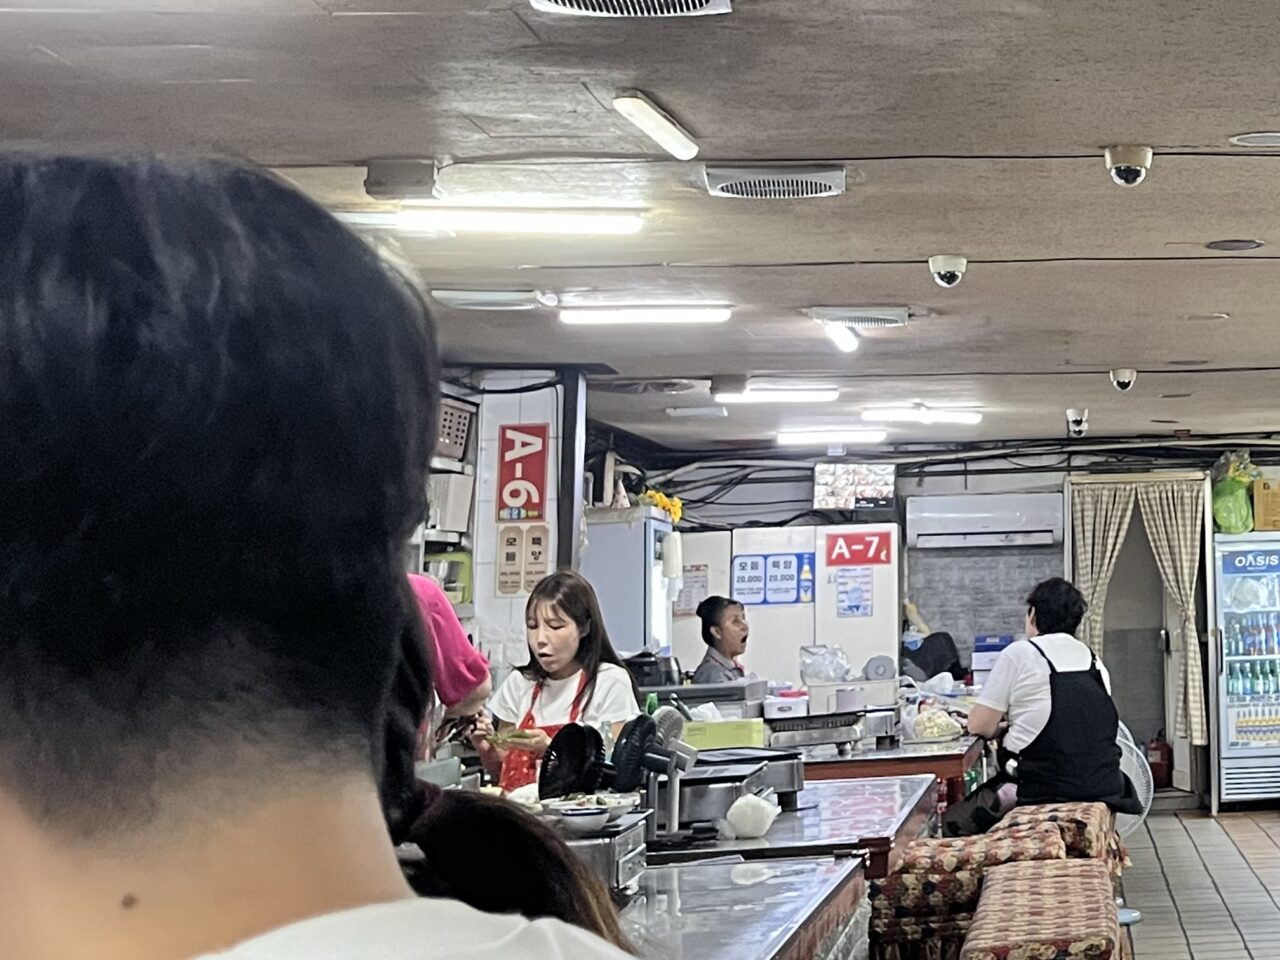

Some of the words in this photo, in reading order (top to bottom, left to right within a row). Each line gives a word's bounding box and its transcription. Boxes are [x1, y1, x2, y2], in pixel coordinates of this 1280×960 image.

[502, 428, 543, 508] A-6
[831, 536, 880, 560] A-7
[1235, 555, 1279, 567] OASIS
